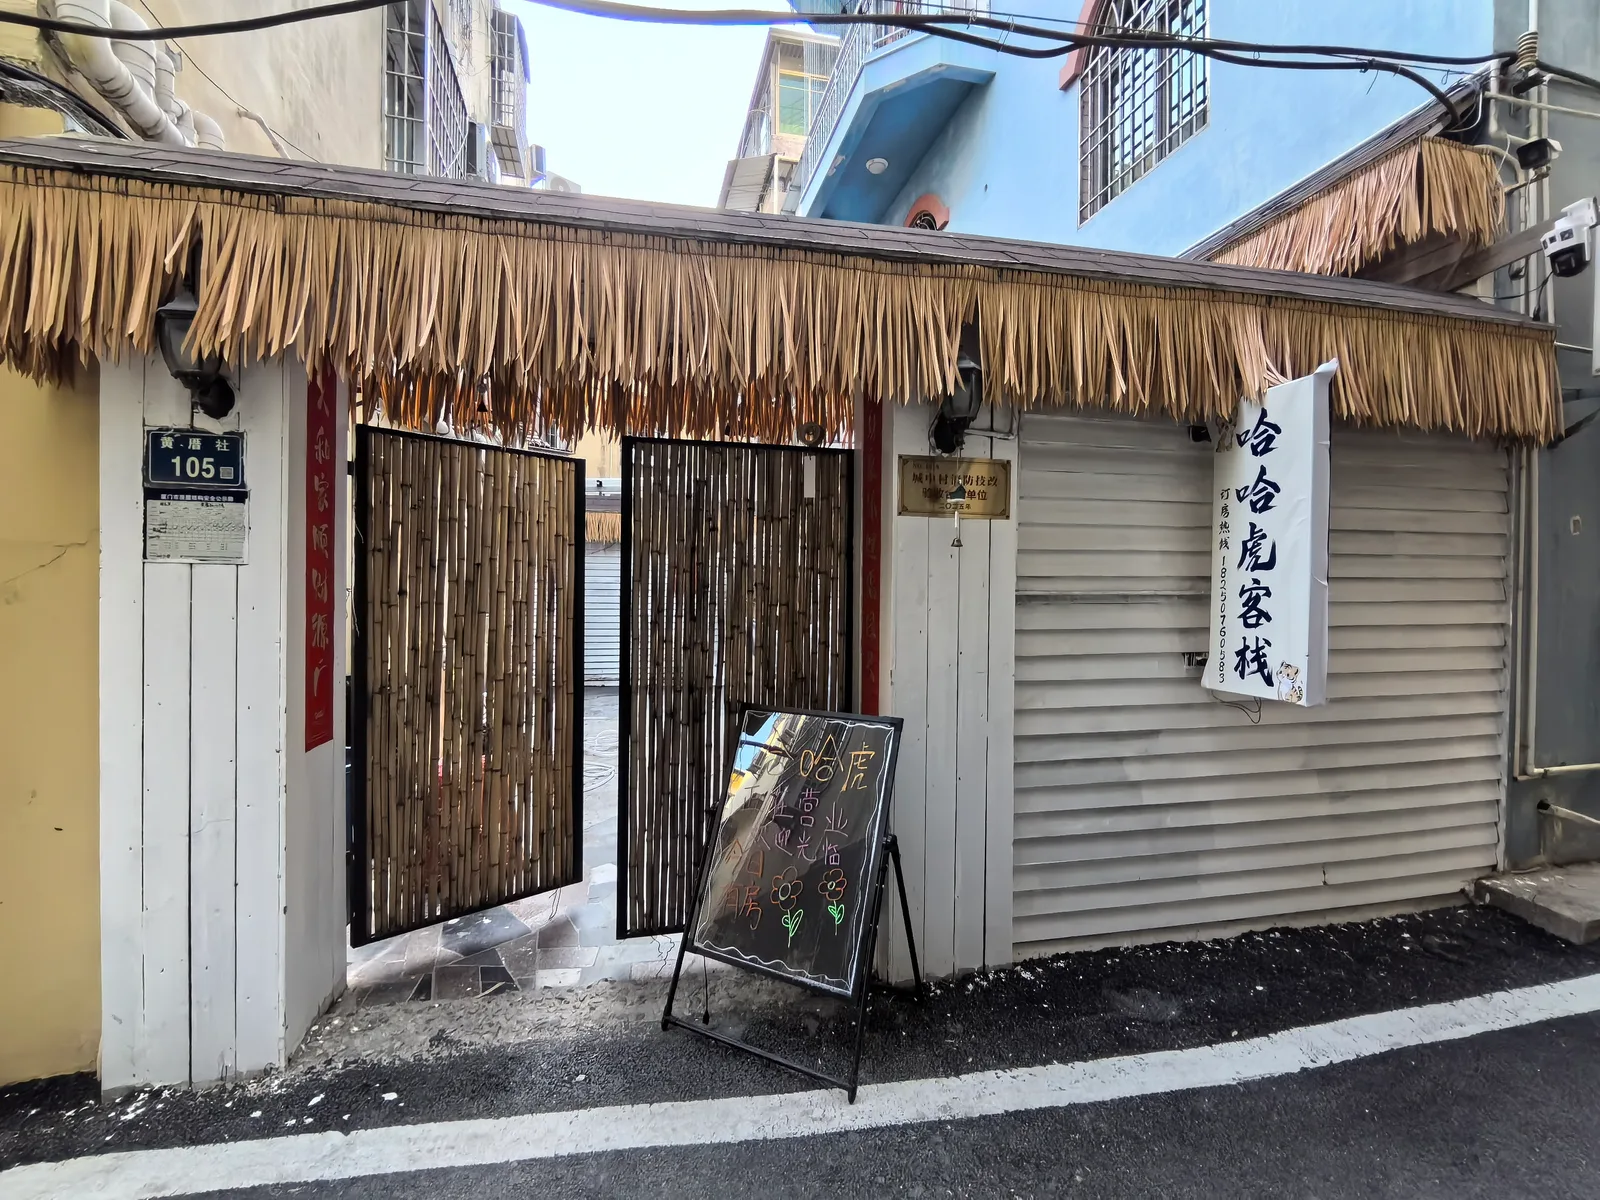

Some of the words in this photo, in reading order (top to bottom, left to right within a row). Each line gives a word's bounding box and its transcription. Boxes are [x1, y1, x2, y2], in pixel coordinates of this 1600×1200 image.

[171, 456, 216, 479] 105
[1219, 488, 1231, 550] 订房热线
[1233, 407, 1282, 687] 哈哈虎客栈
[1217, 555, 1229, 684] 18250760583
